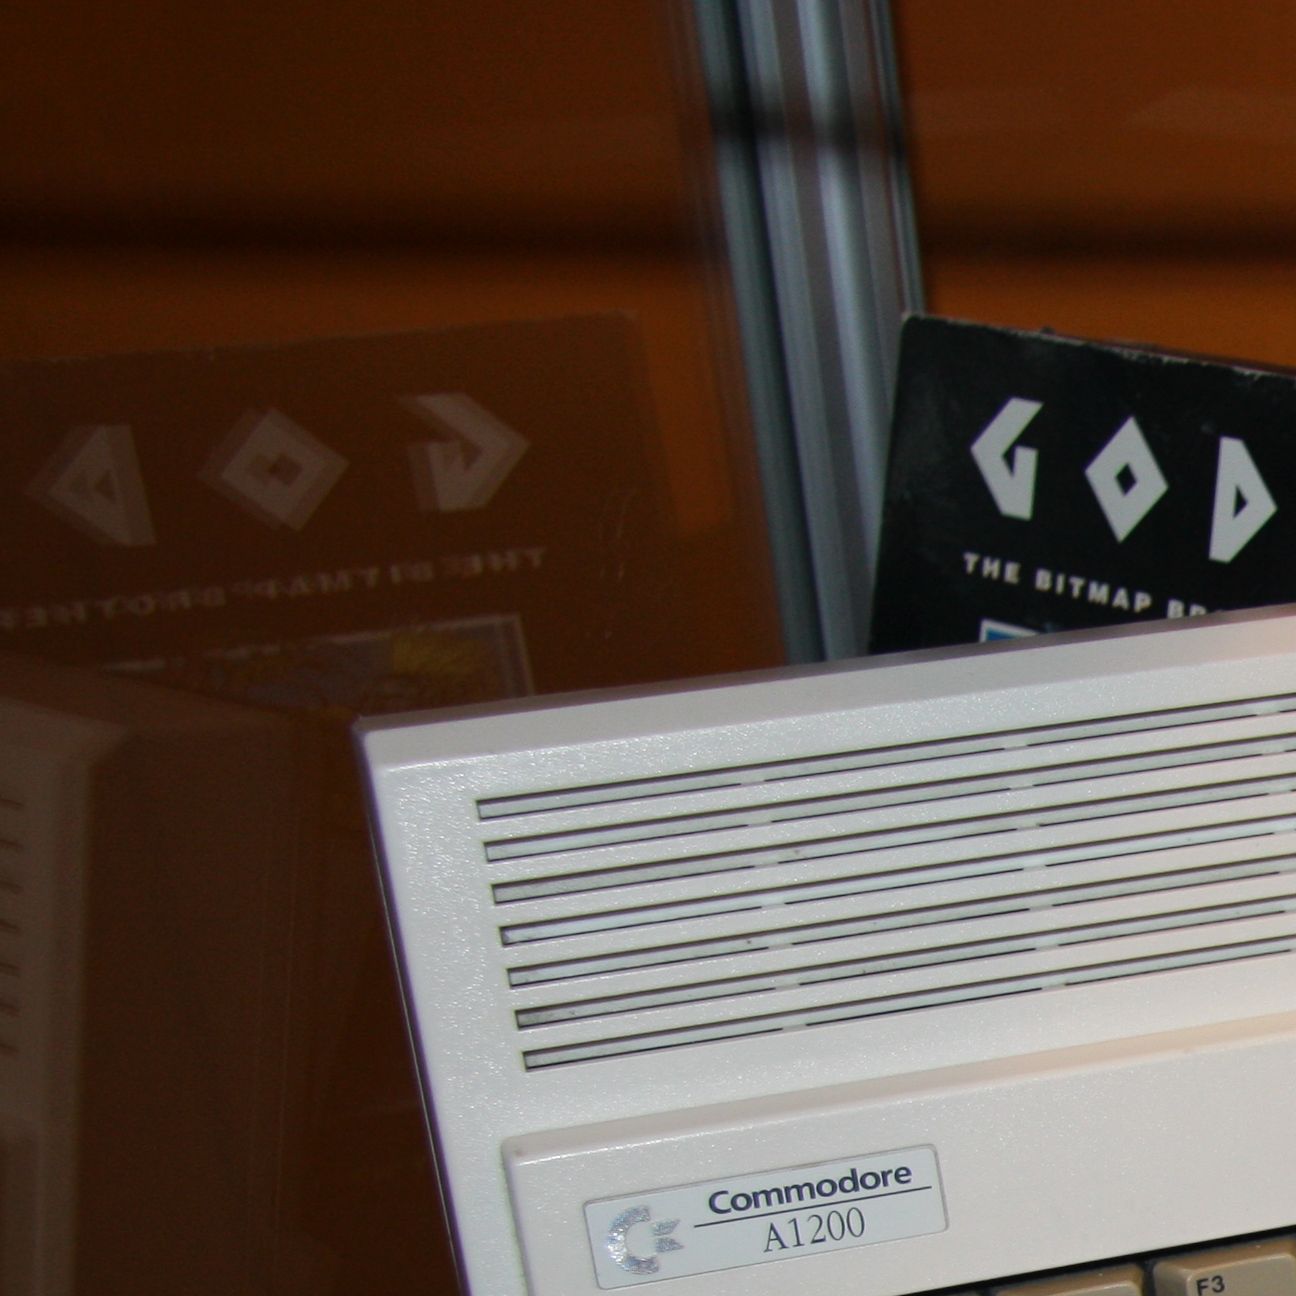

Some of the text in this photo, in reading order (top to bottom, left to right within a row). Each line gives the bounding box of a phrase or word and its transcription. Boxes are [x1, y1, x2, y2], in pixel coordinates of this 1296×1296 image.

[964, 552, 1021, 584] THE
[1035, 569, 1152, 613] BITMAP
[708, 1165, 912, 1215] Commodore
[763, 1207, 866, 1253] A1200
[1196, 1276, 1226, 1296] F3
